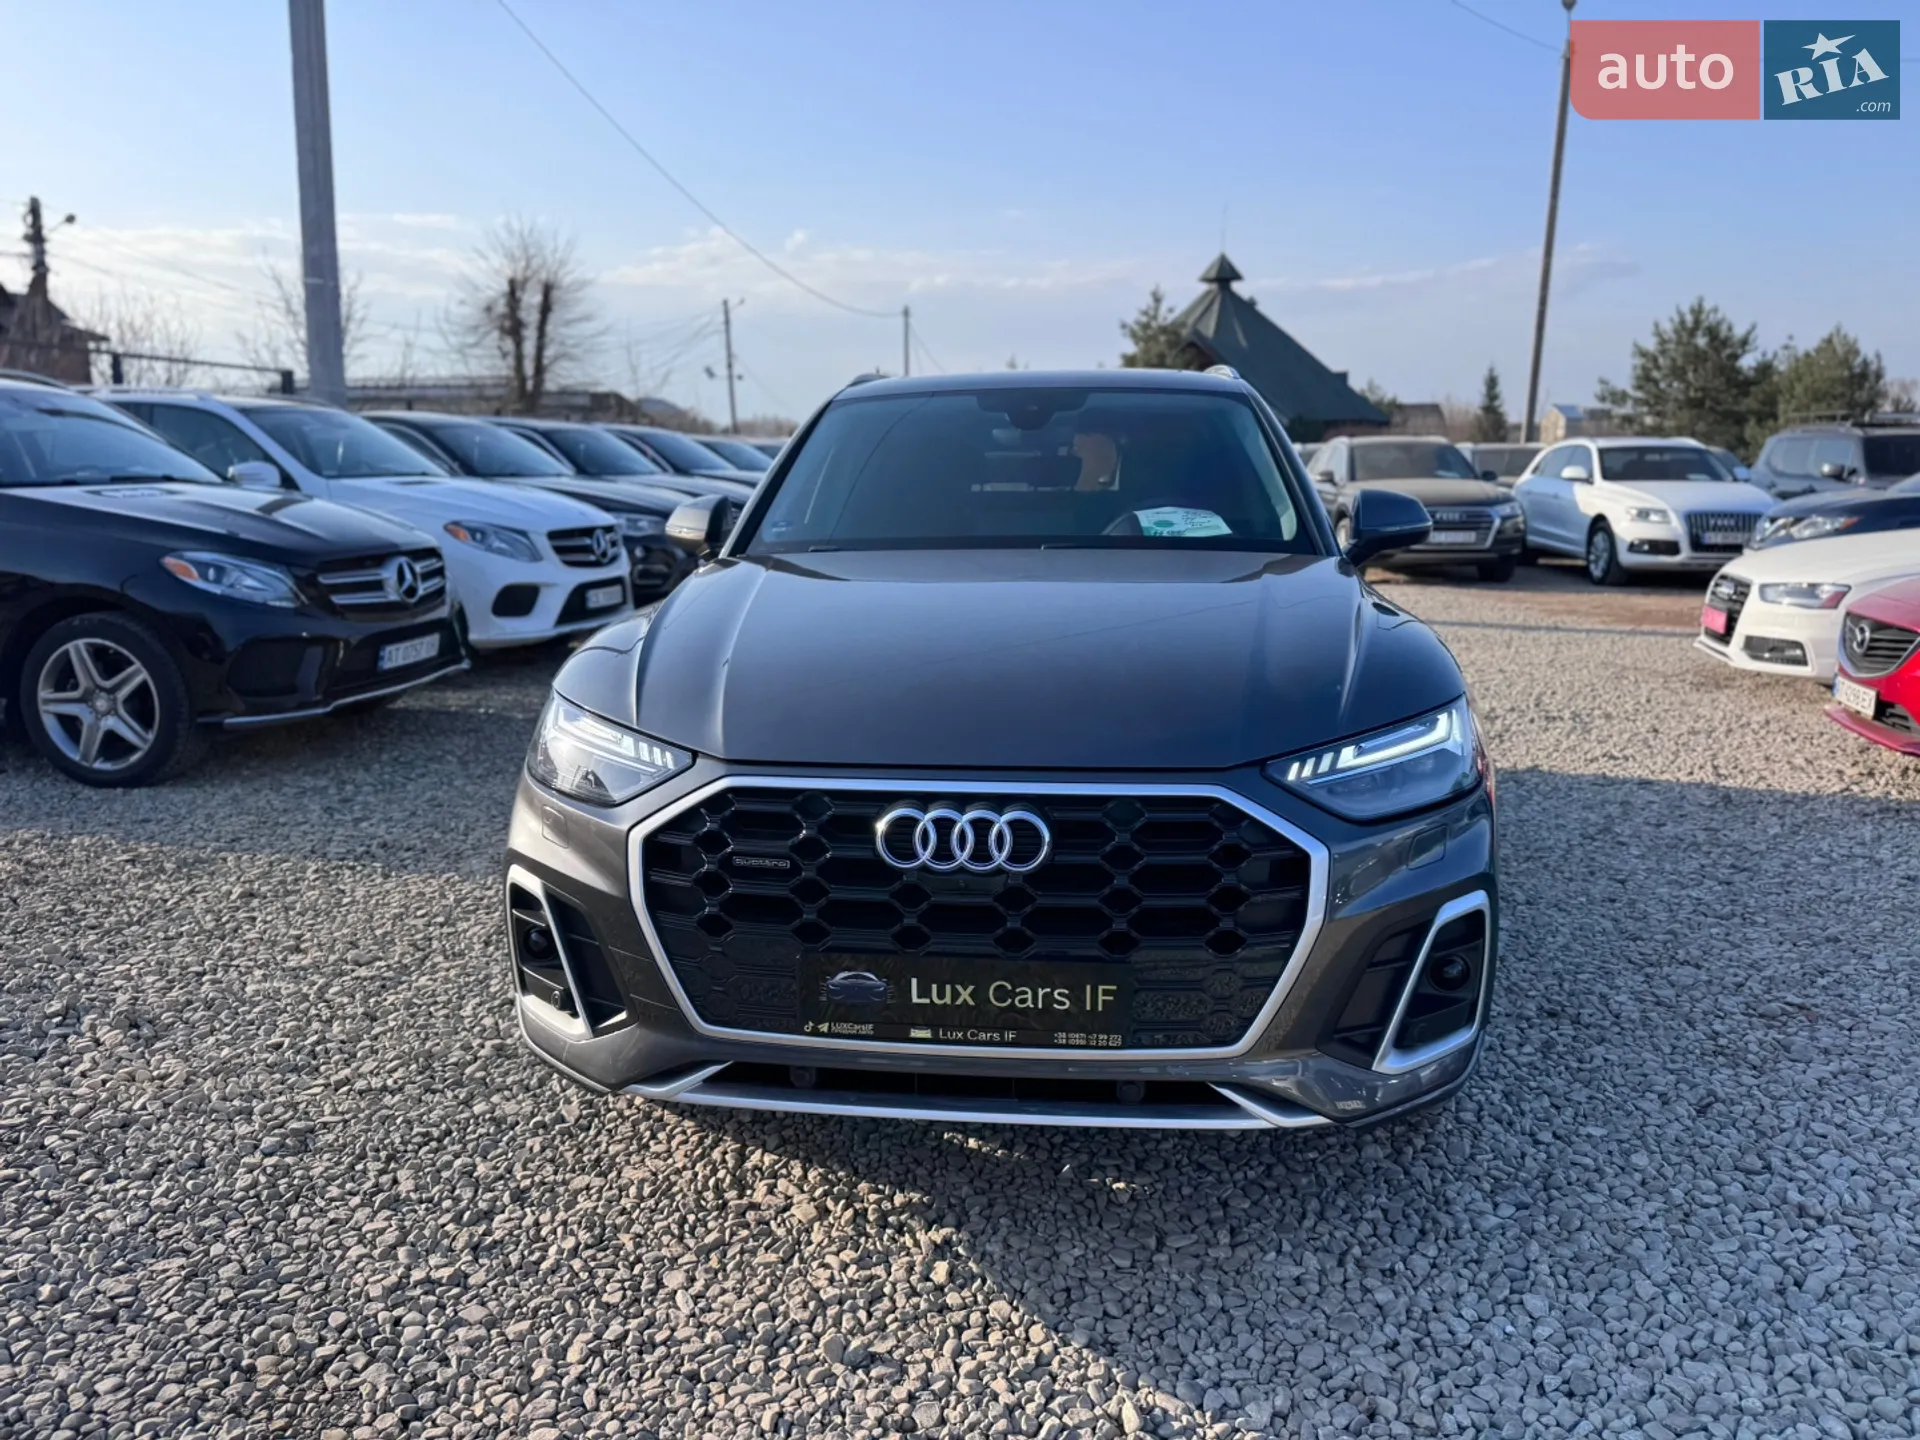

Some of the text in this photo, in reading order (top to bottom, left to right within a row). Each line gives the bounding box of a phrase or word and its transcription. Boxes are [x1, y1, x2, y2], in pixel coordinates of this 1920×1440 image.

[910, 977, 1118, 1012] Lux Cars IF
[938, 1028, 1018, 1042] Lux Cars IF
